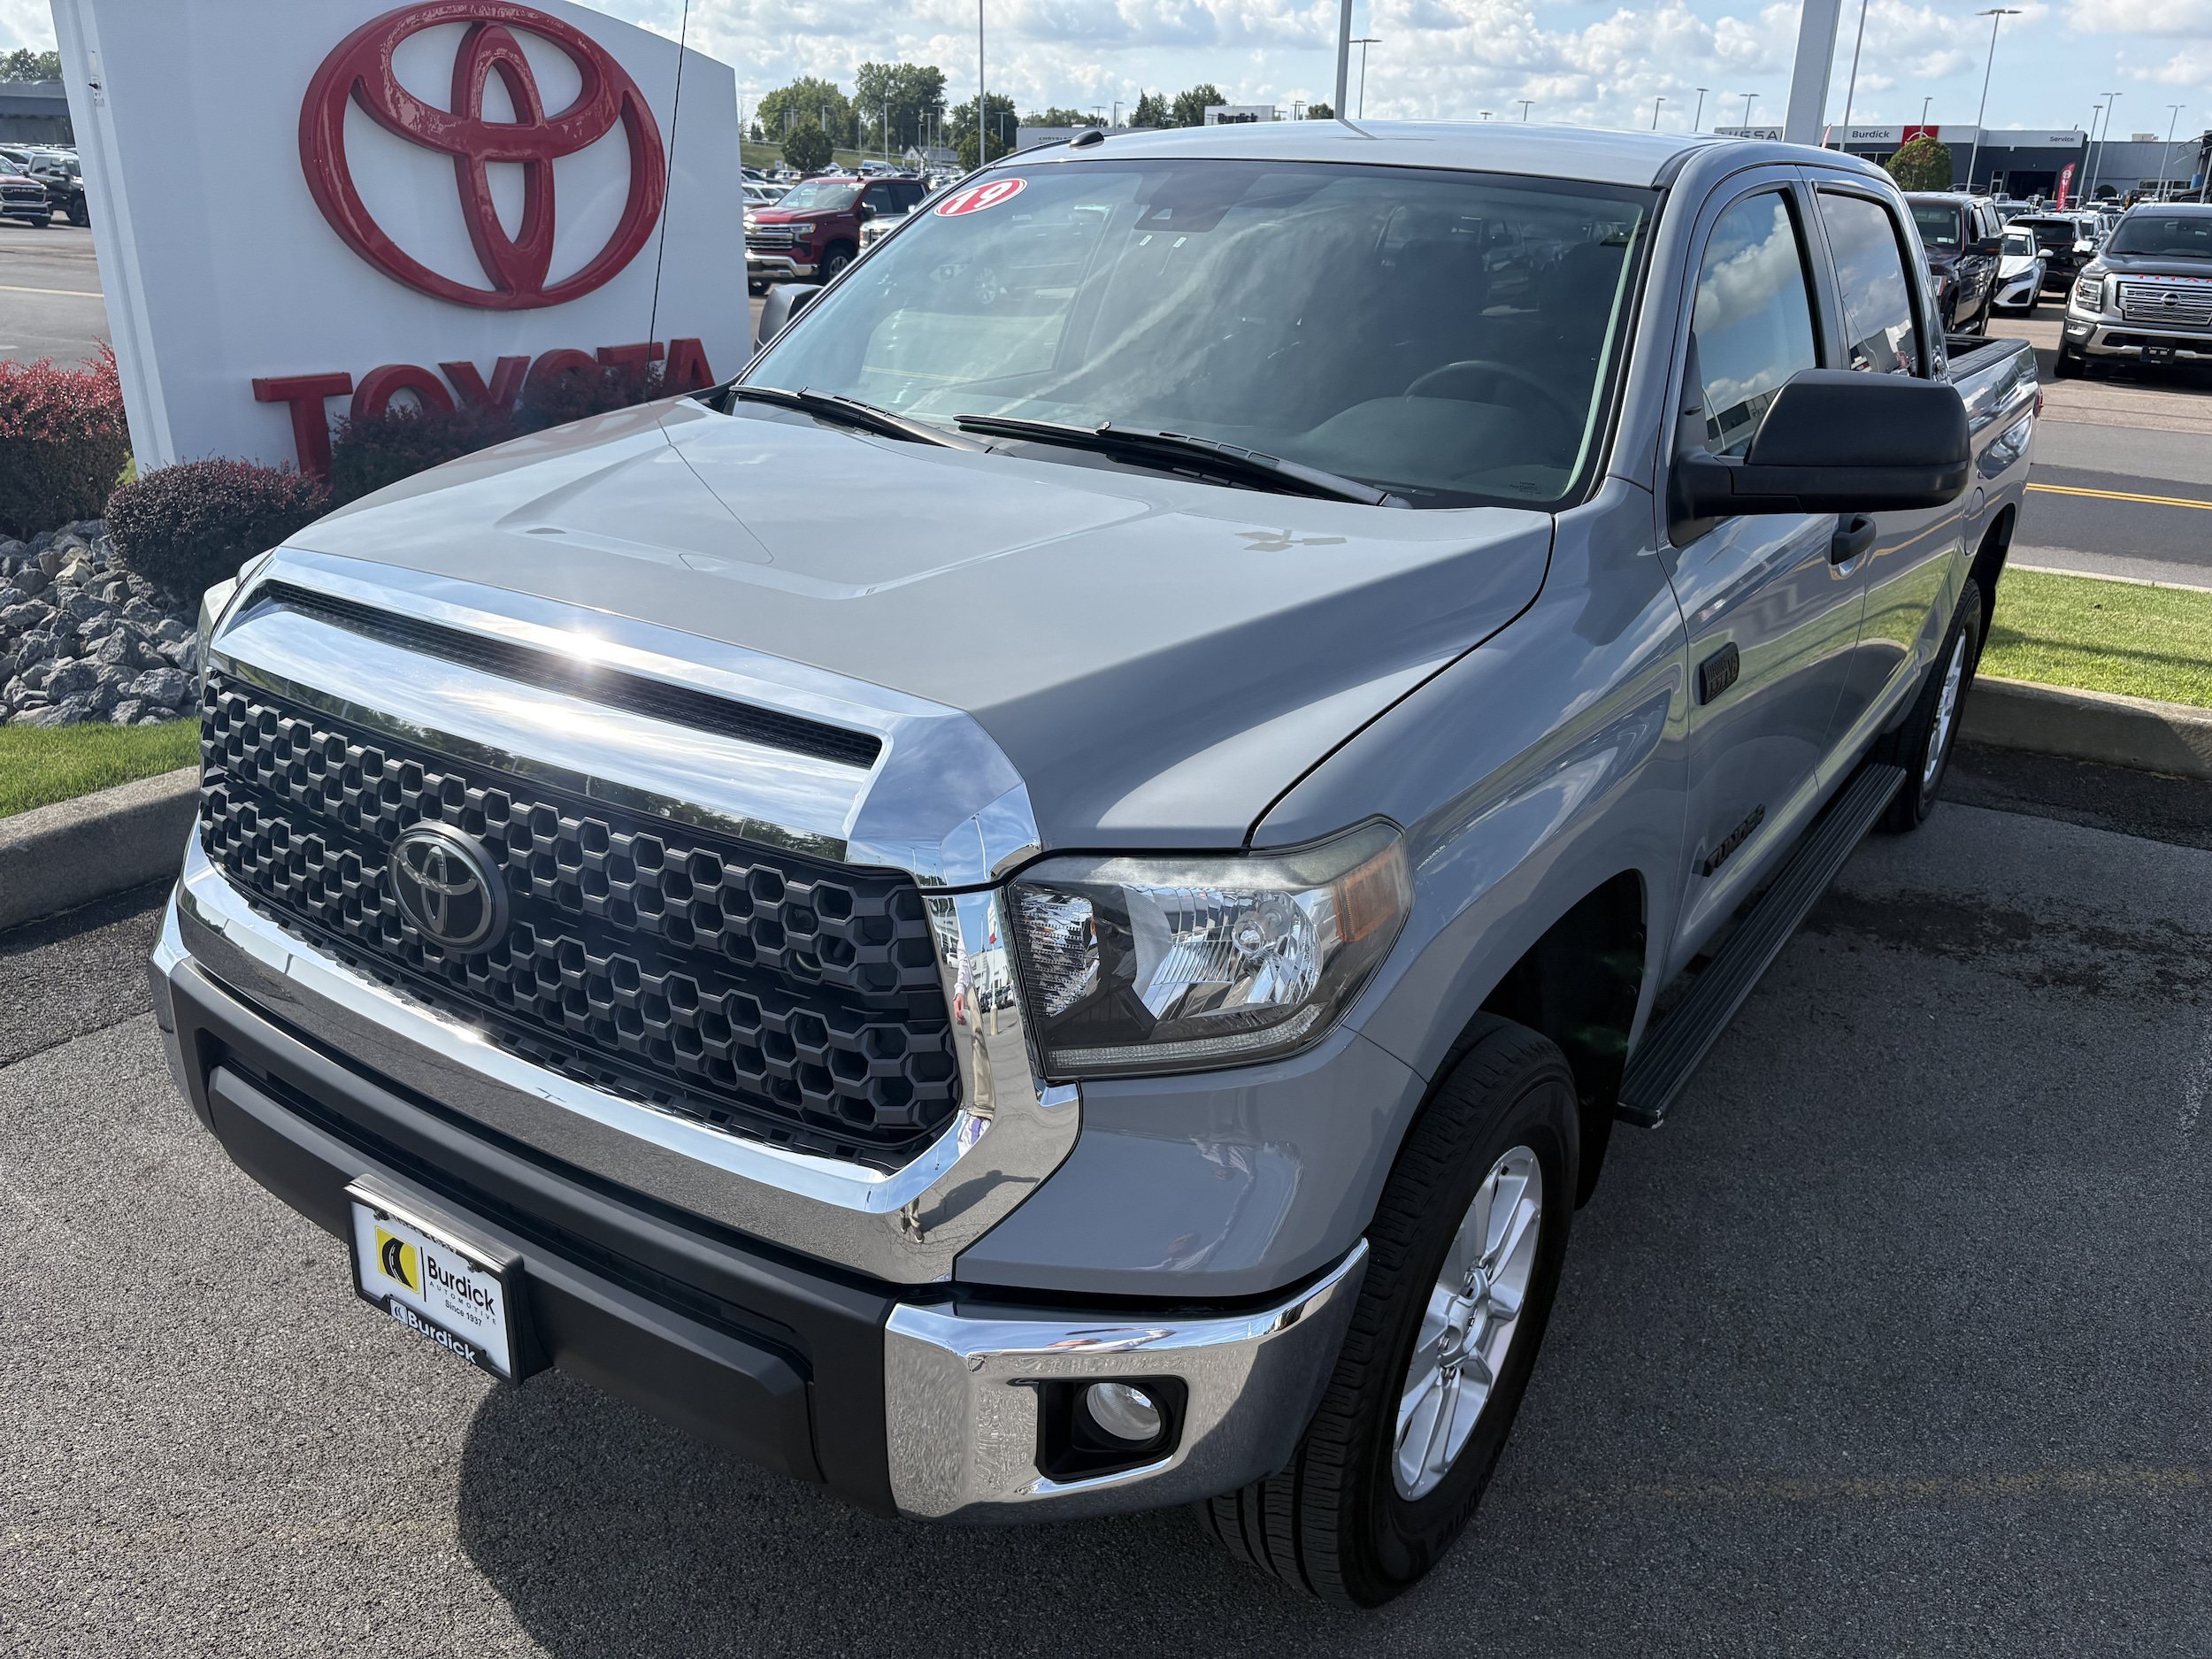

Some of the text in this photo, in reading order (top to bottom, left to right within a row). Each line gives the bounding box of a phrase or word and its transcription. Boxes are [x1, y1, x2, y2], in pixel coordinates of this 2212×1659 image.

[1721, 130, 1784, 141] ISSA
[1852, 130, 1890, 139] Burdick
[945, 181, 1014, 214] 19
[426, 1255, 495, 1316] Burdick
[429, 1281, 496, 1325] AUTOMOTIVE
[445, 1300, 482, 1327] Since 1937
[407, 1312, 476, 1364] Burdick
